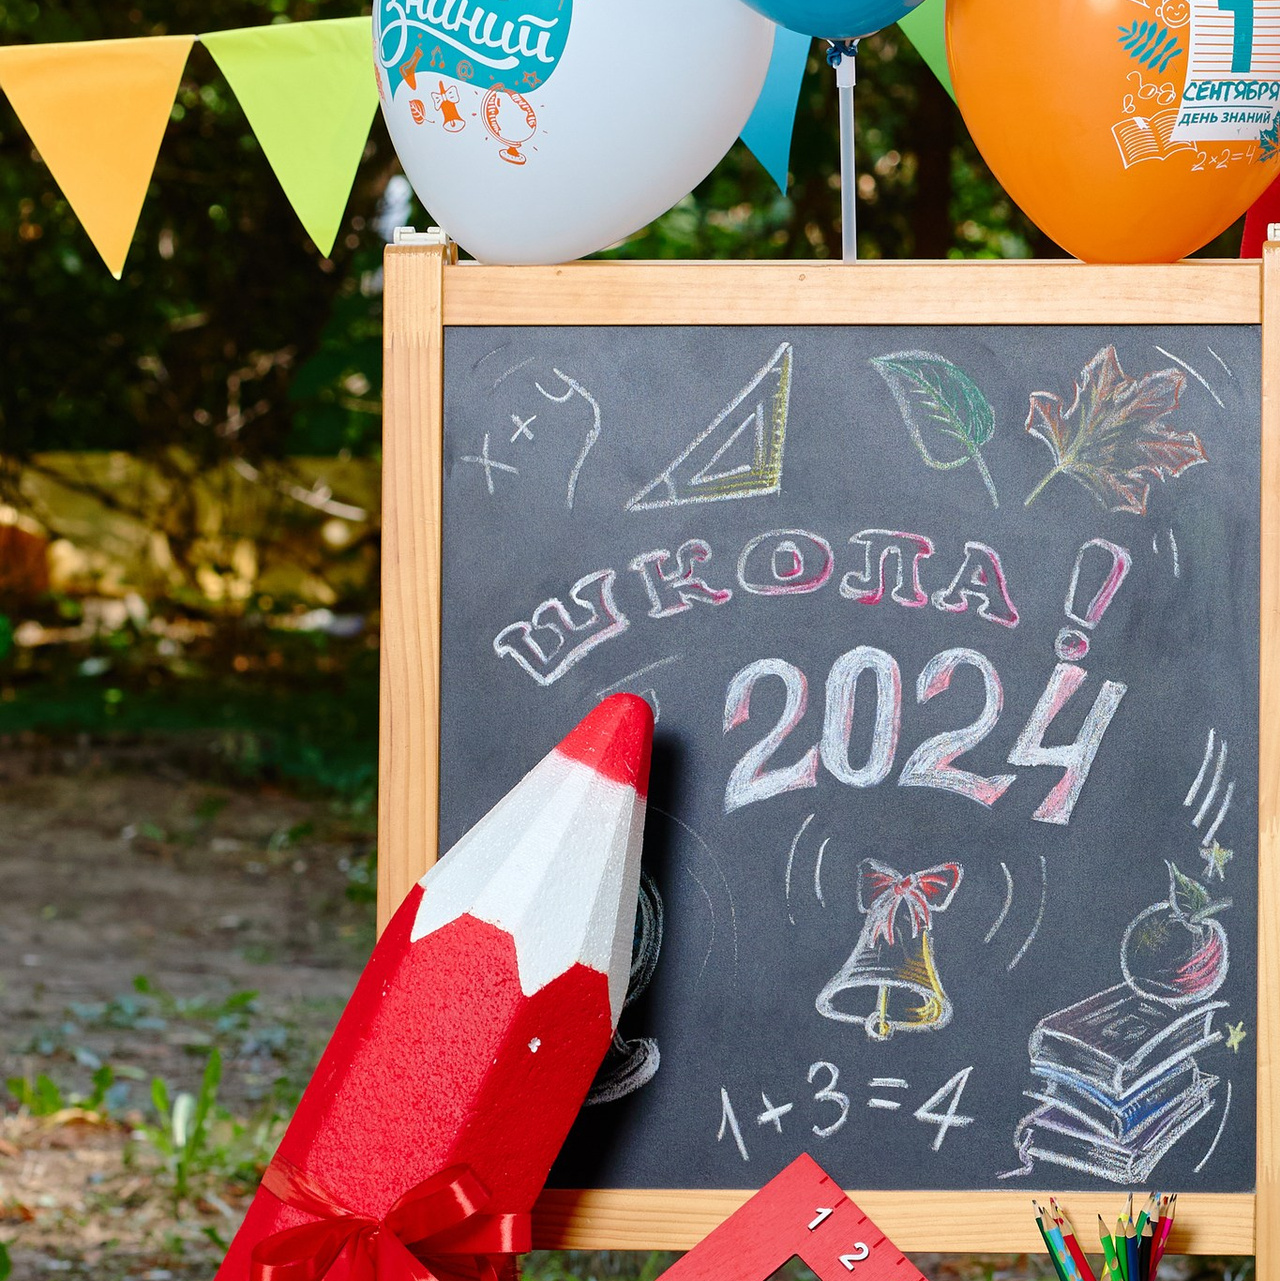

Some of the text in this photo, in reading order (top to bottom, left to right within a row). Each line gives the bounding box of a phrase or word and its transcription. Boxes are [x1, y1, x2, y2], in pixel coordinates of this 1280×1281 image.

[1182, 80, 1280, 102] СЕНТЯБРЯ
[1177, 109, 1271, 127] ДЕНЬ ЗНАНИЙ
[722, 644, 1129, 826] 2024
[807, 1207, 834, 1232] 1
[838, 1241, 870, 1272] 2
